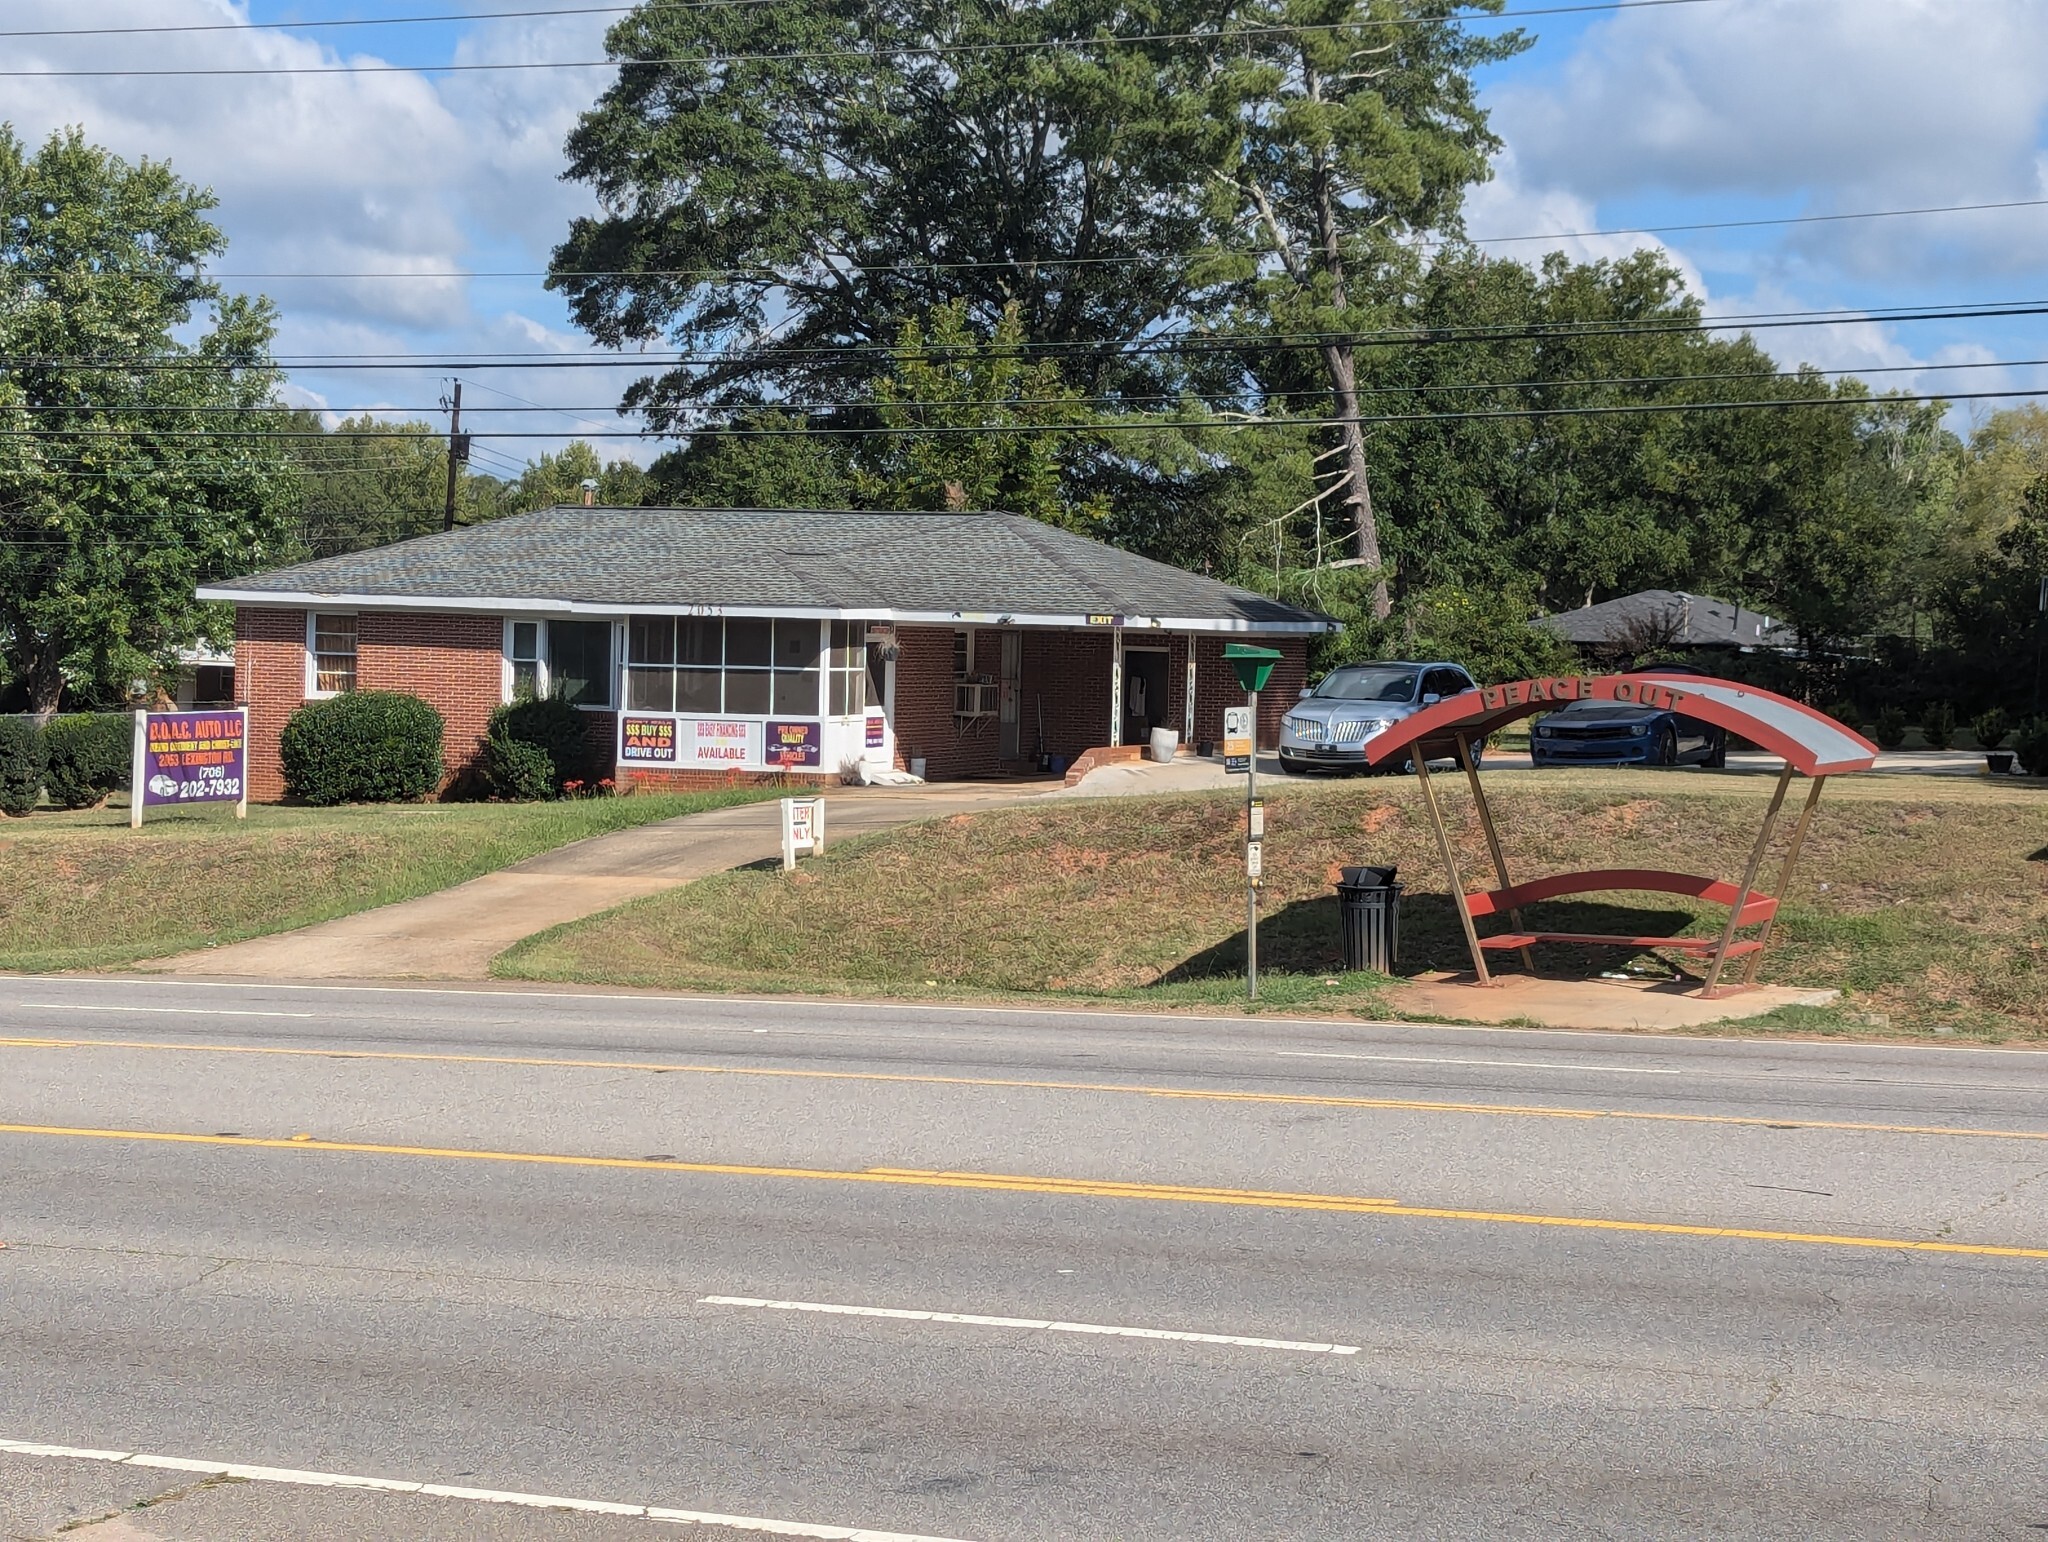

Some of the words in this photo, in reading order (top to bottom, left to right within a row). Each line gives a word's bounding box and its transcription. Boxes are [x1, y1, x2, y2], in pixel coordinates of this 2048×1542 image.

[688, 603, 723, 617] 2053
[1089, 615, 1114, 625] EXIT
[1481, 677, 1594, 710] PEACE
[1614, 679, 1685, 712] OUT
[195, 720, 221, 738] AUTO
[224, 719, 242, 737] LLC
[626, 723, 640, 736] $$$
[641, 724, 658, 736] BUY
[658, 725, 673, 738] $$$
[716, 723, 738, 738] FINANCING
[626, 736, 671, 747] AND
[781, 733, 804, 744] QUALITY
[158, 753, 179, 767] 2053
[182, 751, 222, 766] LEXINGTON
[625, 747, 652, 757] DRIVE
[654, 748, 674, 759] OUT
[697, 747, 746, 759] AVAILABLE
[199, 765, 225, 780] (706)
[179, 778, 240, 798] 202-7932
